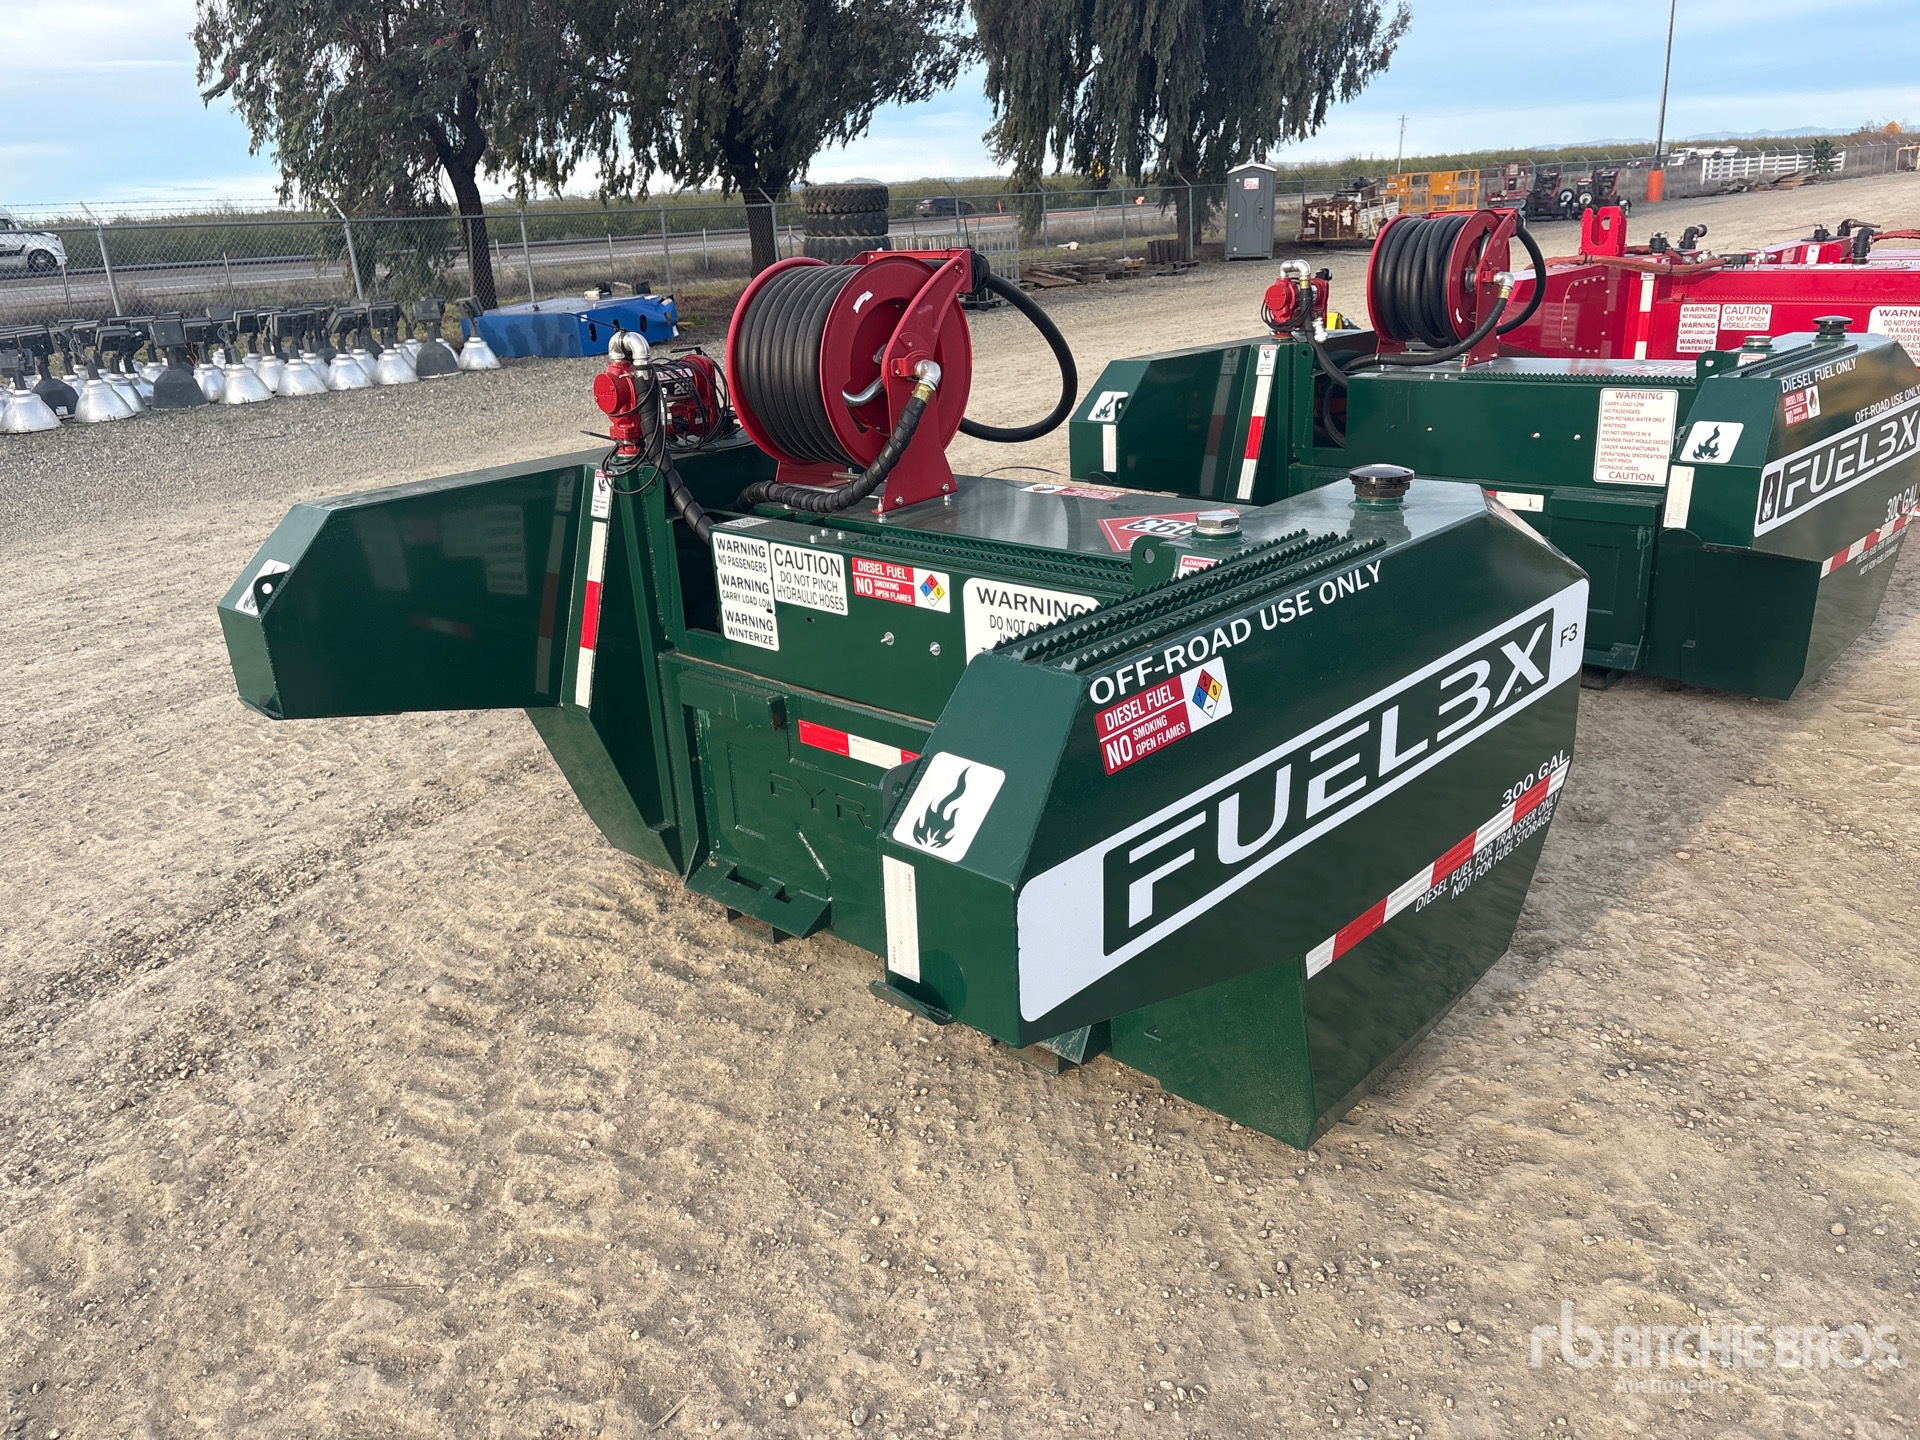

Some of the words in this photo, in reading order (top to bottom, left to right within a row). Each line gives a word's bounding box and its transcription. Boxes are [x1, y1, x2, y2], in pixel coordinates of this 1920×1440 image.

[1724, 306, 1769, 314] CAUTION
[1782, 372, 1814, 394] DIESEL
[1814, 366, 1836, 382] FUEL
[1836, 358, 1857, 374] ONLY
[1615, 392, 1664, 400] WARNING
[1855, 401, 1891, 423] OFF-ROAD
[1891, 395, 1904, 406] USE
[1904, 384, 1920, 400] ONLY
[1786, 410, 1794, 425] NO
[1608, 472, 1654, 481] CAUTION
[716, 537, 766, 558] WARNING
[718, 554, 726, 566] NO
[728, 555, 768, 574] PASSENGERS
[774, 547, 841, 578] CAUTION
[858, 560, 885, 576] DIESEL
[886, 566, 908, 580] FUEL
[1189, 560, 1214, 569] DANG
[720, 572, 770, 595] WARNING
[780, 570, 792, 584] DO
[794, 574, 810, 588] NOT
[812, 578, 839, 594] PINCH
[856, 576, 873, 595] NO
[874, 580, 900, 591] SMOKING
[722, 590, 740, 602] CARRY
[742, 594, 758, 605] LOAD
[758, 598, 772, 610] LOW
[776, 584, 818, 606] HYDRAULIC
[820, 592, 845, 612] HOSES
[874, 589, 890, 599] OPEN
[890, 592, 912, 603] FLAMES
[725, 609, 774, 632] WARNING
[990, 614, 1004, 630] DO
[1006, 616, 1026, 634] NOT
[1089, 618, 1252, 704] OFF-ROAD
[1260, 590, 1314, 631] USE
[1318, 560, 1382, 605] ONLY
[727, 626, 774, 646] WINTERIZE
[1560, 622, 1578, 648] F3
[1202, 675, 1208, 688] 2
[1212, 684, 1218, 696] 0
[1104, 698, 1146, 732] DIESEL
[1146, 684, 1175, 711] FUEL
[1132, 714, 1168, 741] SMOKING
[1135, 736, 1156, 756] OPEN
[1156, 722, 1186, 746] FLAMES
[1106, 734, 1133, 770] NO
[1501, 773, 1534, 808] 300
[1538, 750, 1570, 780] GAL.
[769, 770, 872, 830] FYR
[1415, 880, 1448, 913] DIESEL
[1450, 861, 1473, 886] FUEL
[1474, 842, 1494, 867] FOR
[1495, 808, 1536, 850] TRANSFER
[1537, 788, 1561, 816] ONLY
[1452, 872, 1474, 900] NOT
[1474, 856, 1492, 882] FOR
[1494, 844, 1514, 866] FUEL
[1514, 807, 1553, 848] STORAGE
